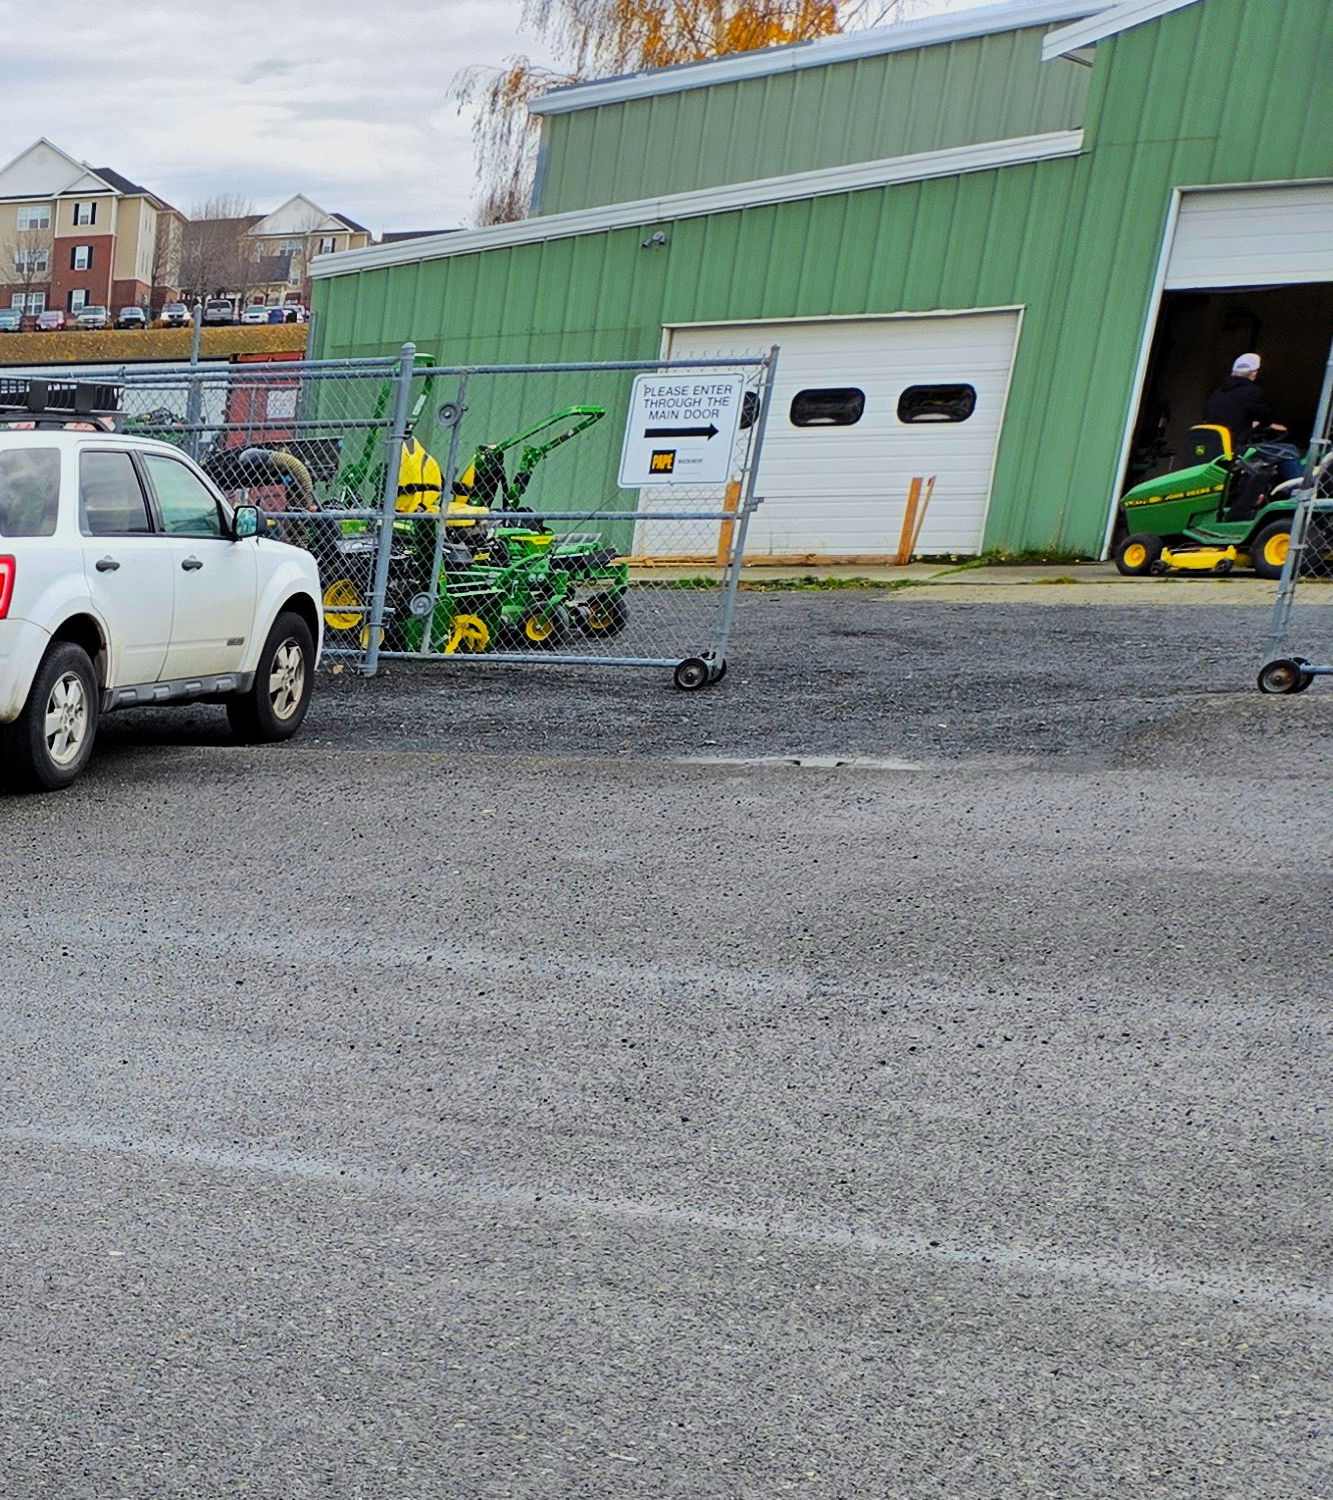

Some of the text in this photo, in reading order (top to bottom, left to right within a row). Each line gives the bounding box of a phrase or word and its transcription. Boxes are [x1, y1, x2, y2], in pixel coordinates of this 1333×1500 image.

[644, 384, 733, 397] PLEASE ENTER
[644, 396, 731, 409] THROUGH THE
[648, 408, 720, 420] MAIN DOOR
